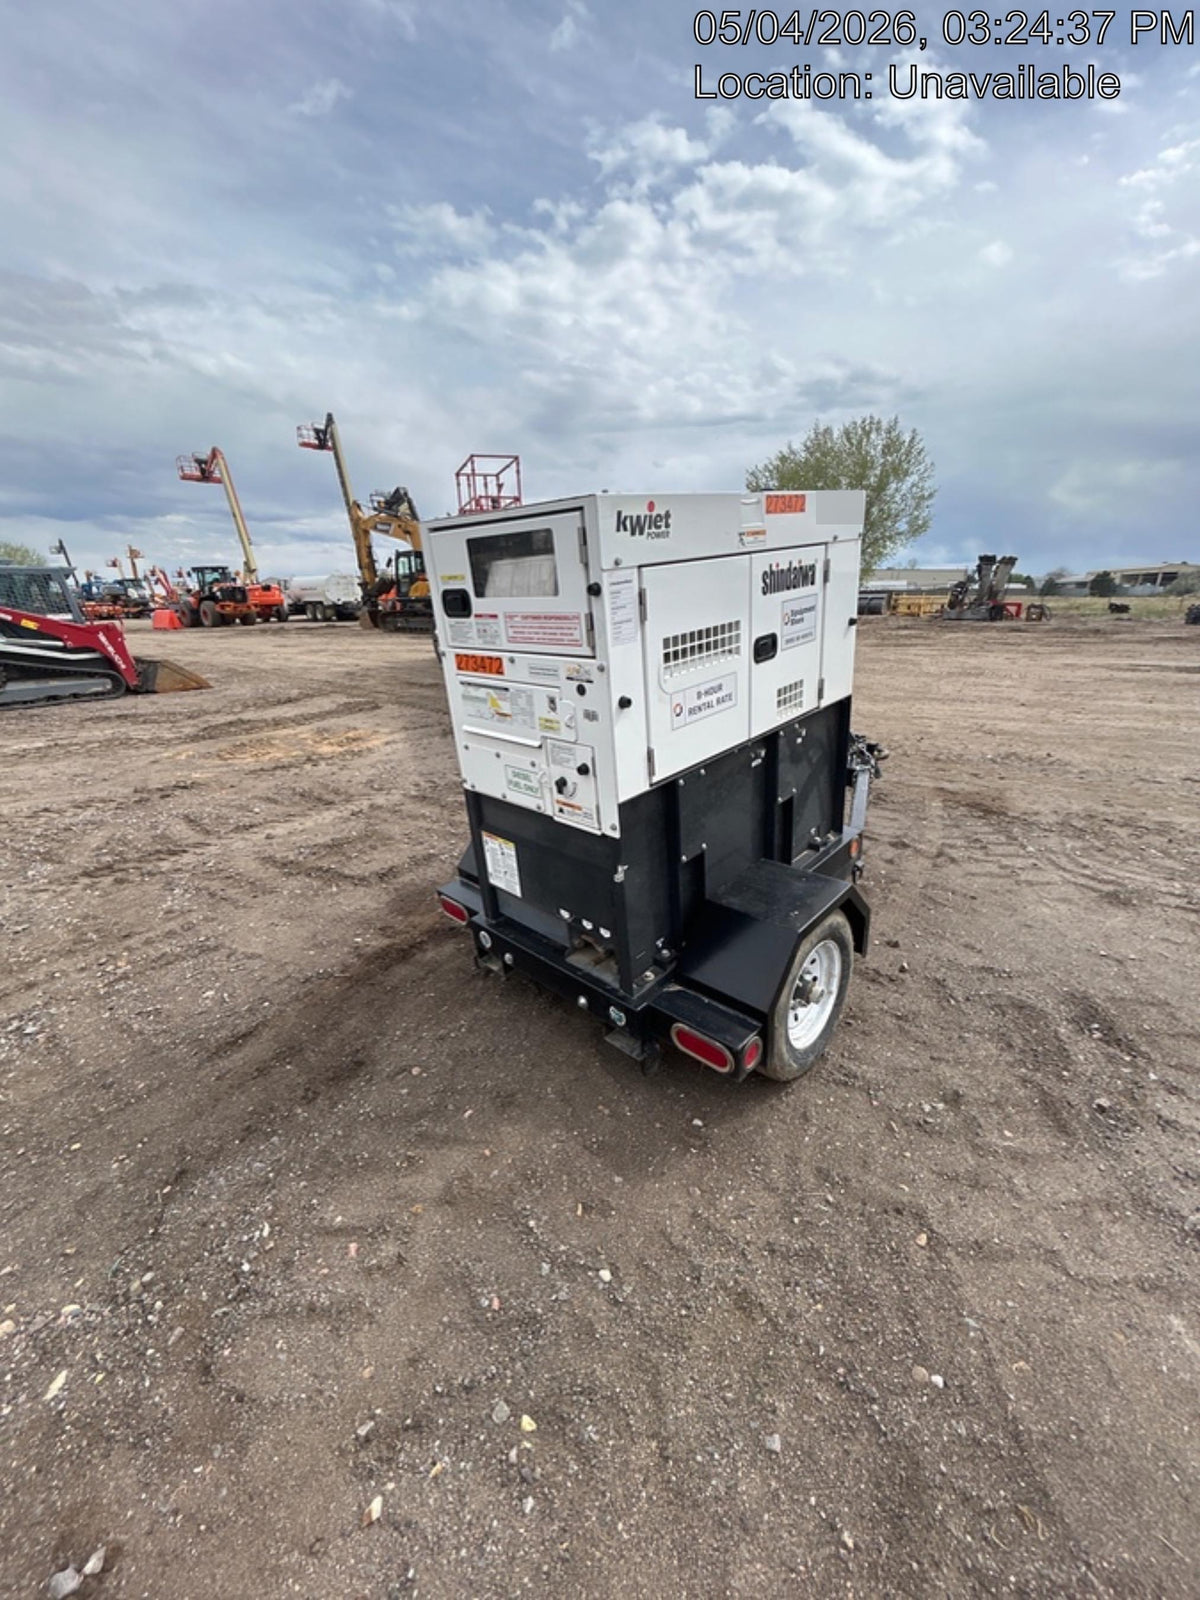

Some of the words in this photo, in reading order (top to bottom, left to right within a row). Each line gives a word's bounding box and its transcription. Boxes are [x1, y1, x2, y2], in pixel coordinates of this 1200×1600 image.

[766, 493, 806, 514] 273472
[616, 500, 671, 537] kwiet
[646, 530, 671, 540] POWER
[762, 558, 816, 596] shindaiwa
[455, 653, 505, 676] 273472
[688, 699, 714, 716] RENTAL
[716, 691, 733, 706] RATE
